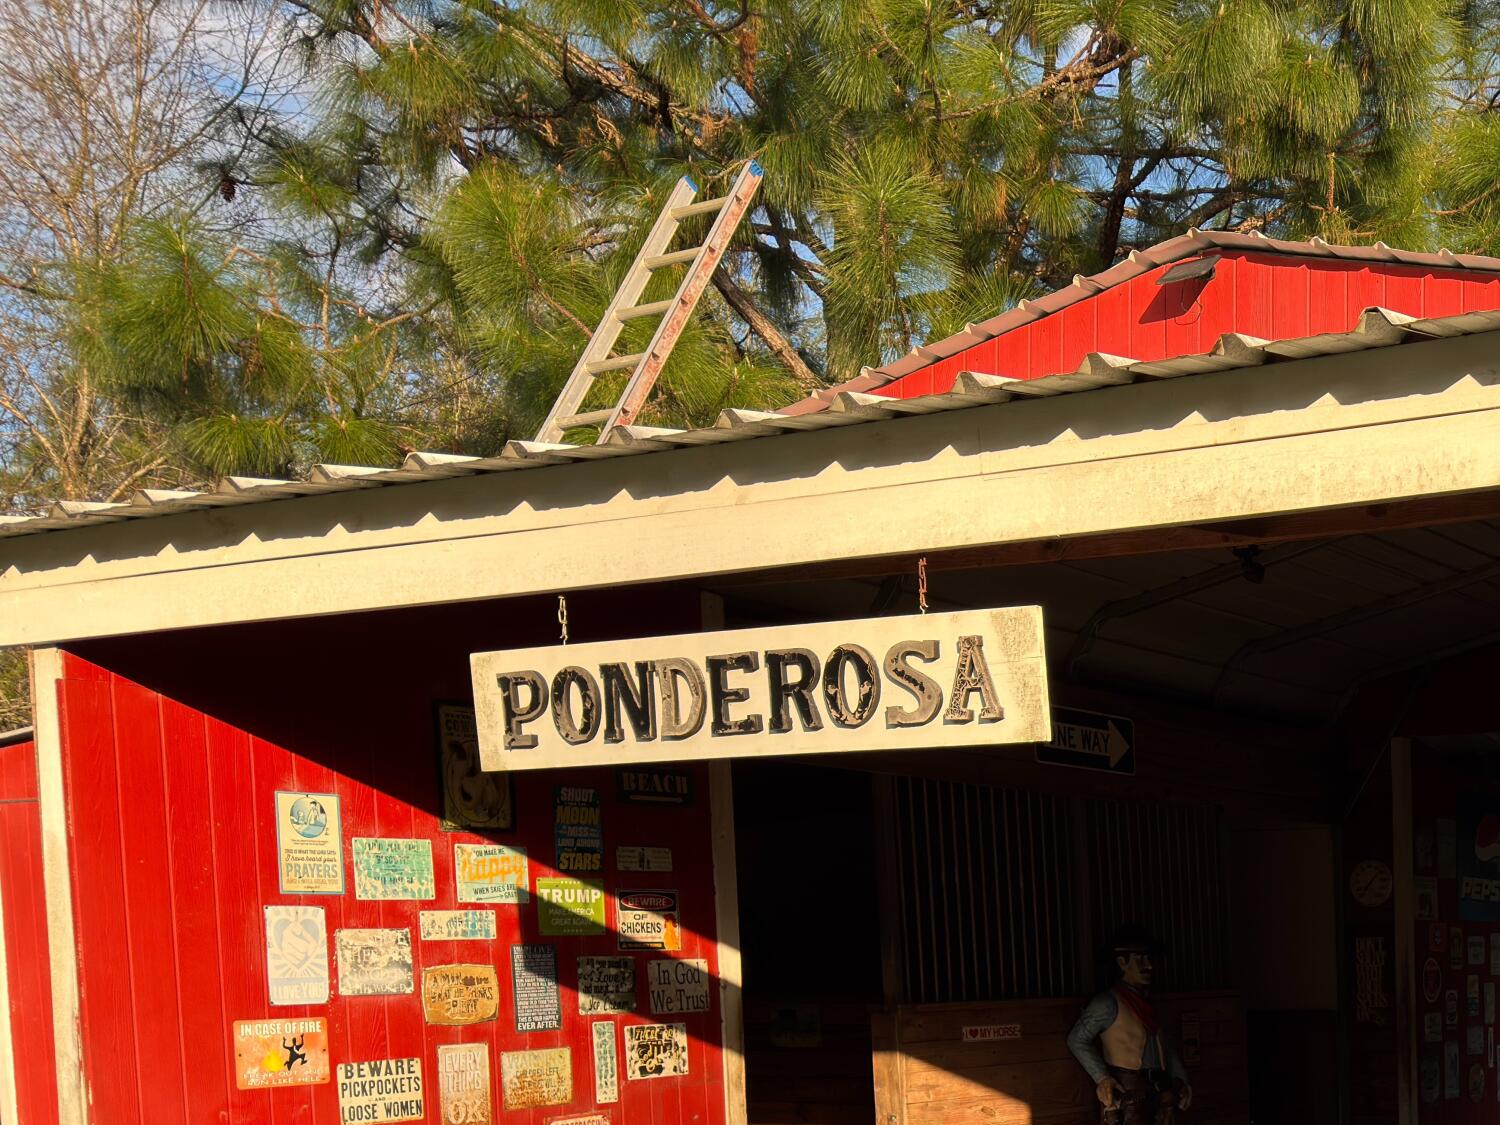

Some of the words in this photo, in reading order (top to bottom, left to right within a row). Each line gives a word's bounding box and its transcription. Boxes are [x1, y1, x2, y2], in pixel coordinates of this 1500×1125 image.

[496, 634, 1005, 751] PONDEROSA
[1054, 725, 1076, 748] NE
[1081, 728, 1111, 753] WAY
[623, 771, 689, 795] BEACH
[556, 806, 600, 825] MOON
[472, 848, 483, 857] OU
[559, 852, 601, 871] STARS
[286, 863, 338, 878] PRAYERS
[461, 848, 525, 888] happy
[540, 888, 601, 903] TRUMP
[628, 896, 668, 907] BEWARE
[567, 907, 595, 916] AMERICA
[633, 913, 648, 921] OF
[621, 922, 662, 933] CHICKENS
[657, 962, 671, 985] In
[675, 961, 701, 985] God
[651, 989, 674, 1013] We
[676, 989, 709, 1011] Trust
[240, 1023, 252, 1036] IN
[255, 1022, 282, 1035] CASE
[284, 1021, 298, 1034] OF
[300, 1020, 322, 1033] FIRE
[518, 1022, 536, 1031] EVER
[344, 1059, 416, 1079] BEWARE
[445, 1052, 481, 1073] EVERY
[545, 1066, 559, 1076] LEFT
[341, 1077, 421, 1099] PICKPOCKETS
[446, 1070, 482, 1092] THING
[342, 1104, 378, 1123] LOOSE
[384, 1099, 422, 1118] WOMEN
